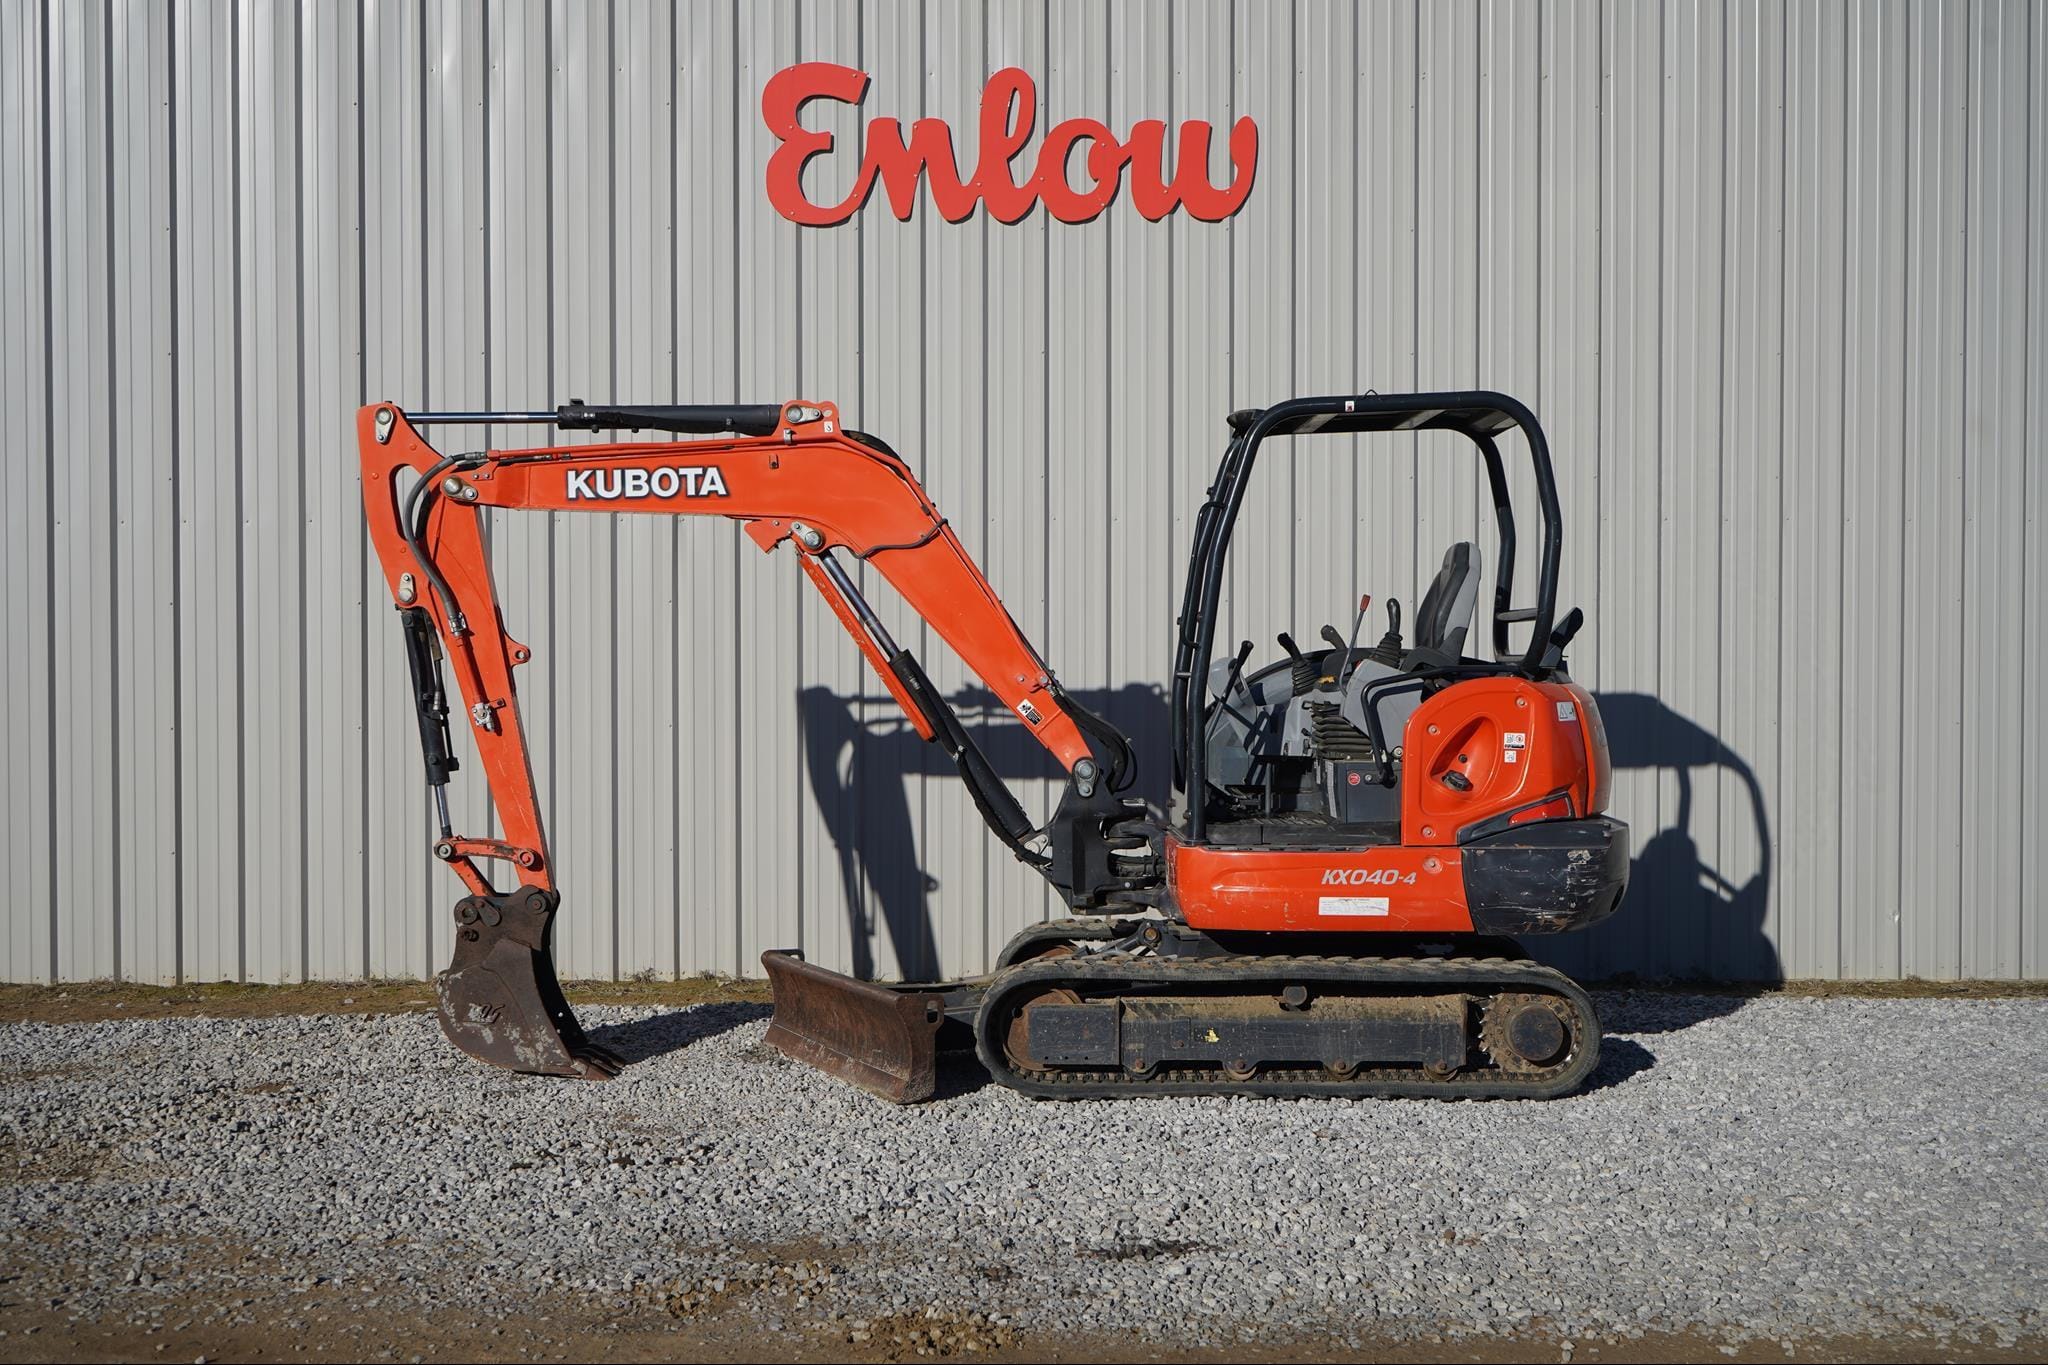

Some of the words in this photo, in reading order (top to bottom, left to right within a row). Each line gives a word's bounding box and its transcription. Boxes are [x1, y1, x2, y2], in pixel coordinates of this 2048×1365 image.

[762, 62, 1257, 226] Enlow
[566, 466, 728, 499] KUBOTA
[1321, 868, 1417, 886] KX040-4
